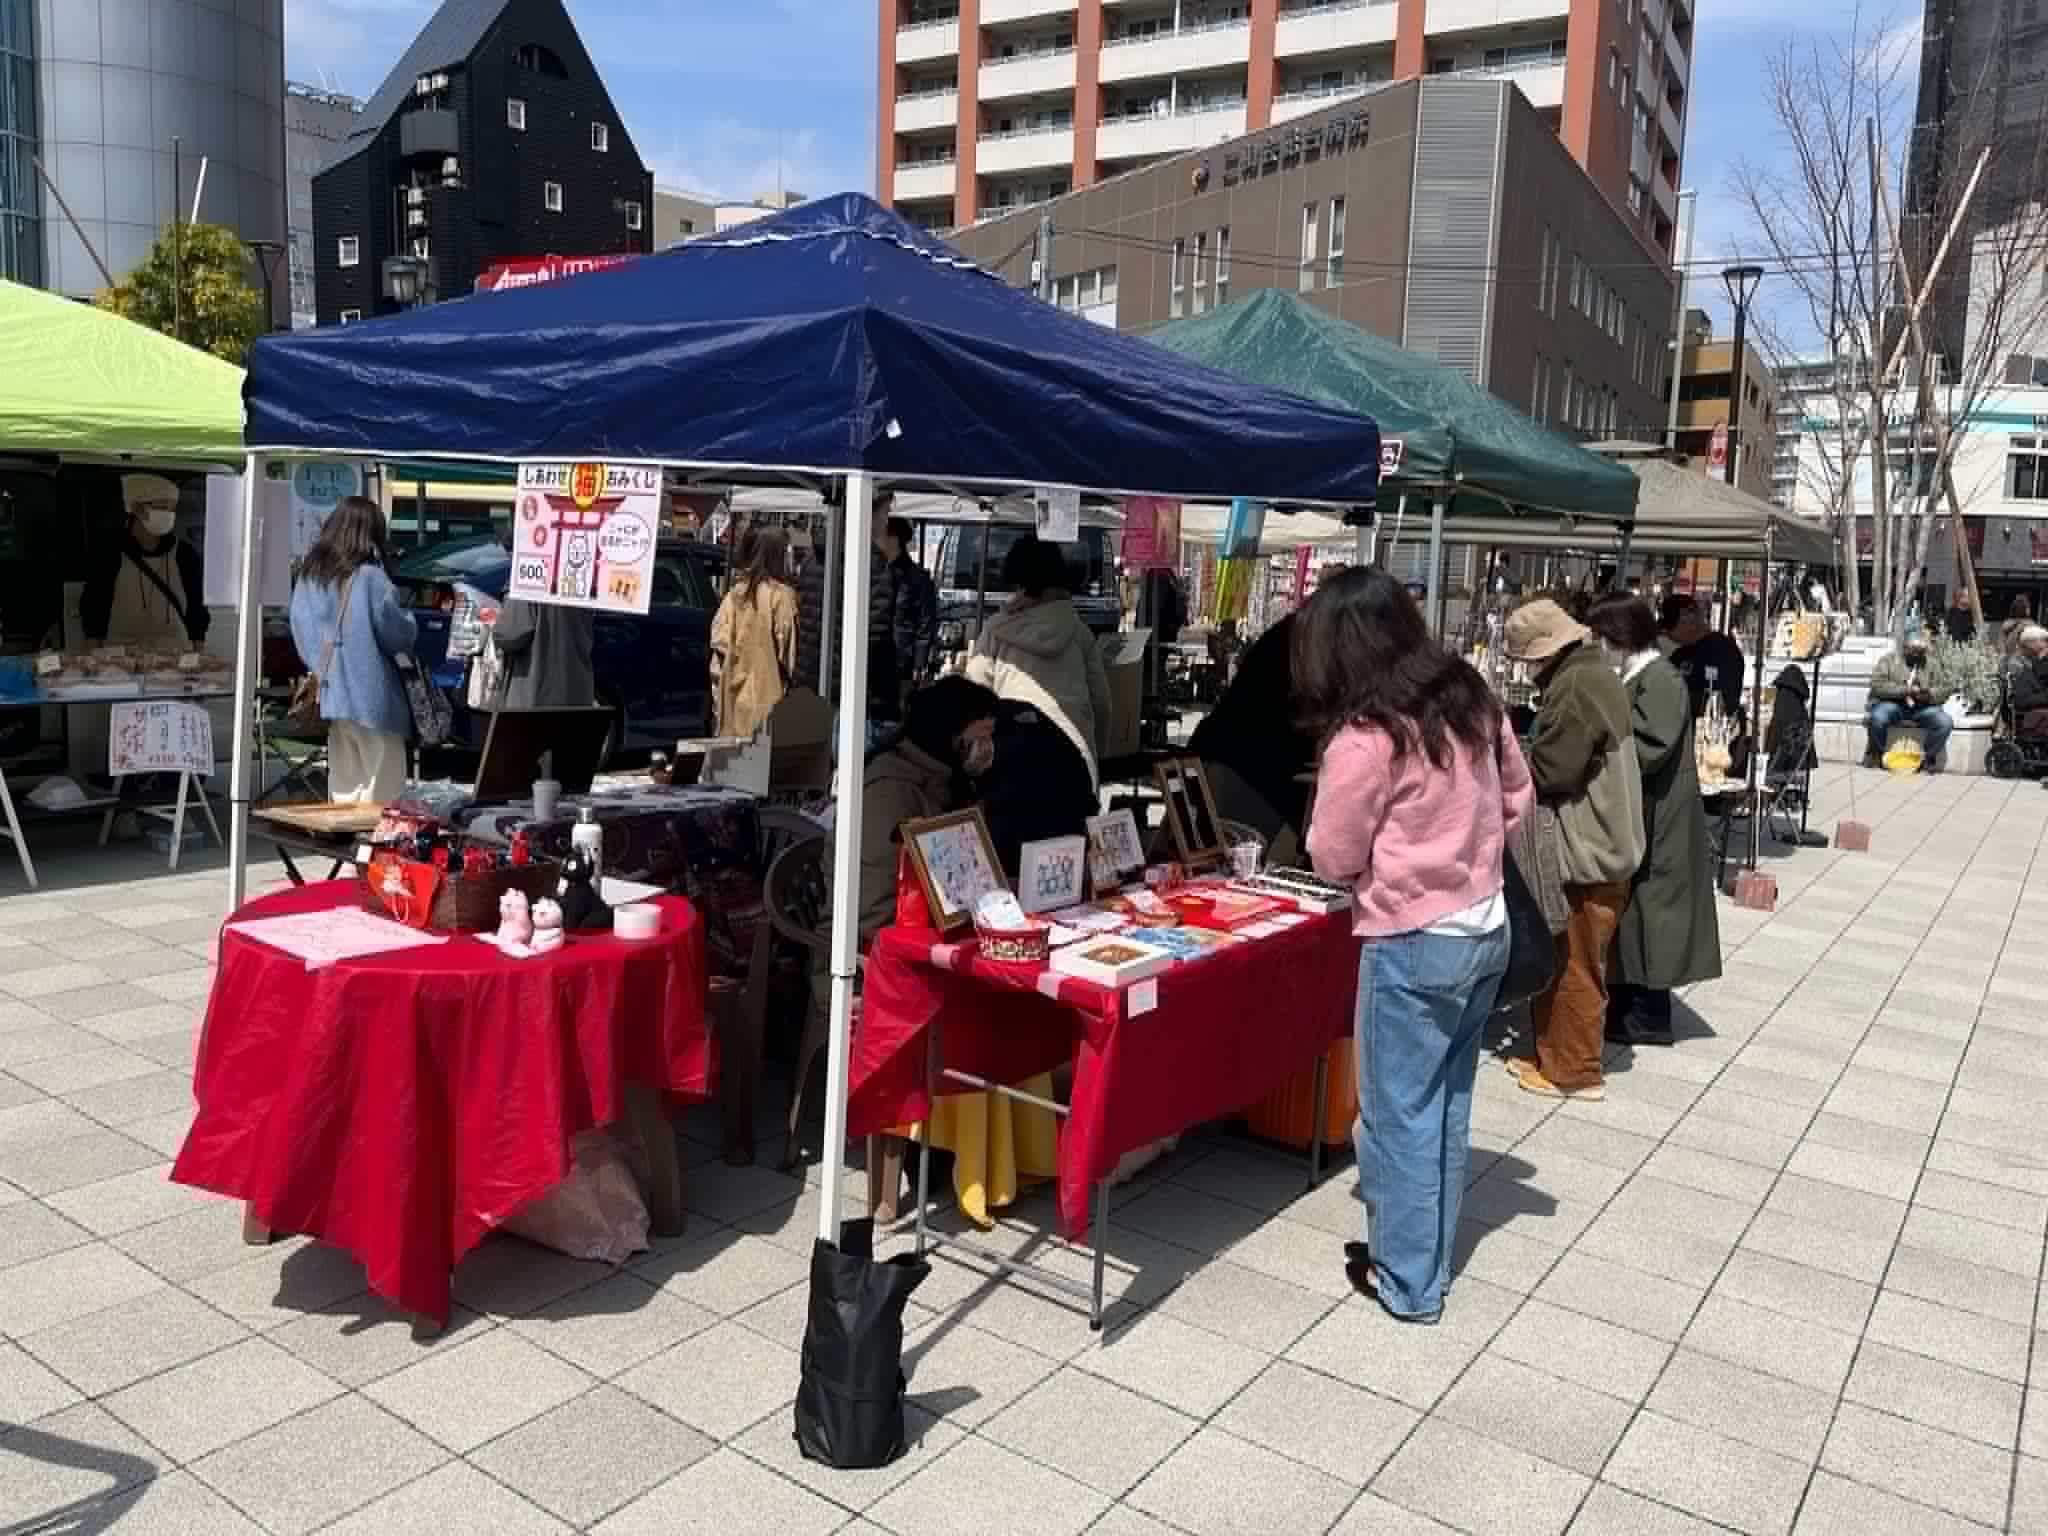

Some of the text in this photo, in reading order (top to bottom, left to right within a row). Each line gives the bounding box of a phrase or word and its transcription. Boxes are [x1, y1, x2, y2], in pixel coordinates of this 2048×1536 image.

[523, 467, 567, 485] しあわせ
[608, 469, 656, 488] おみくじ
